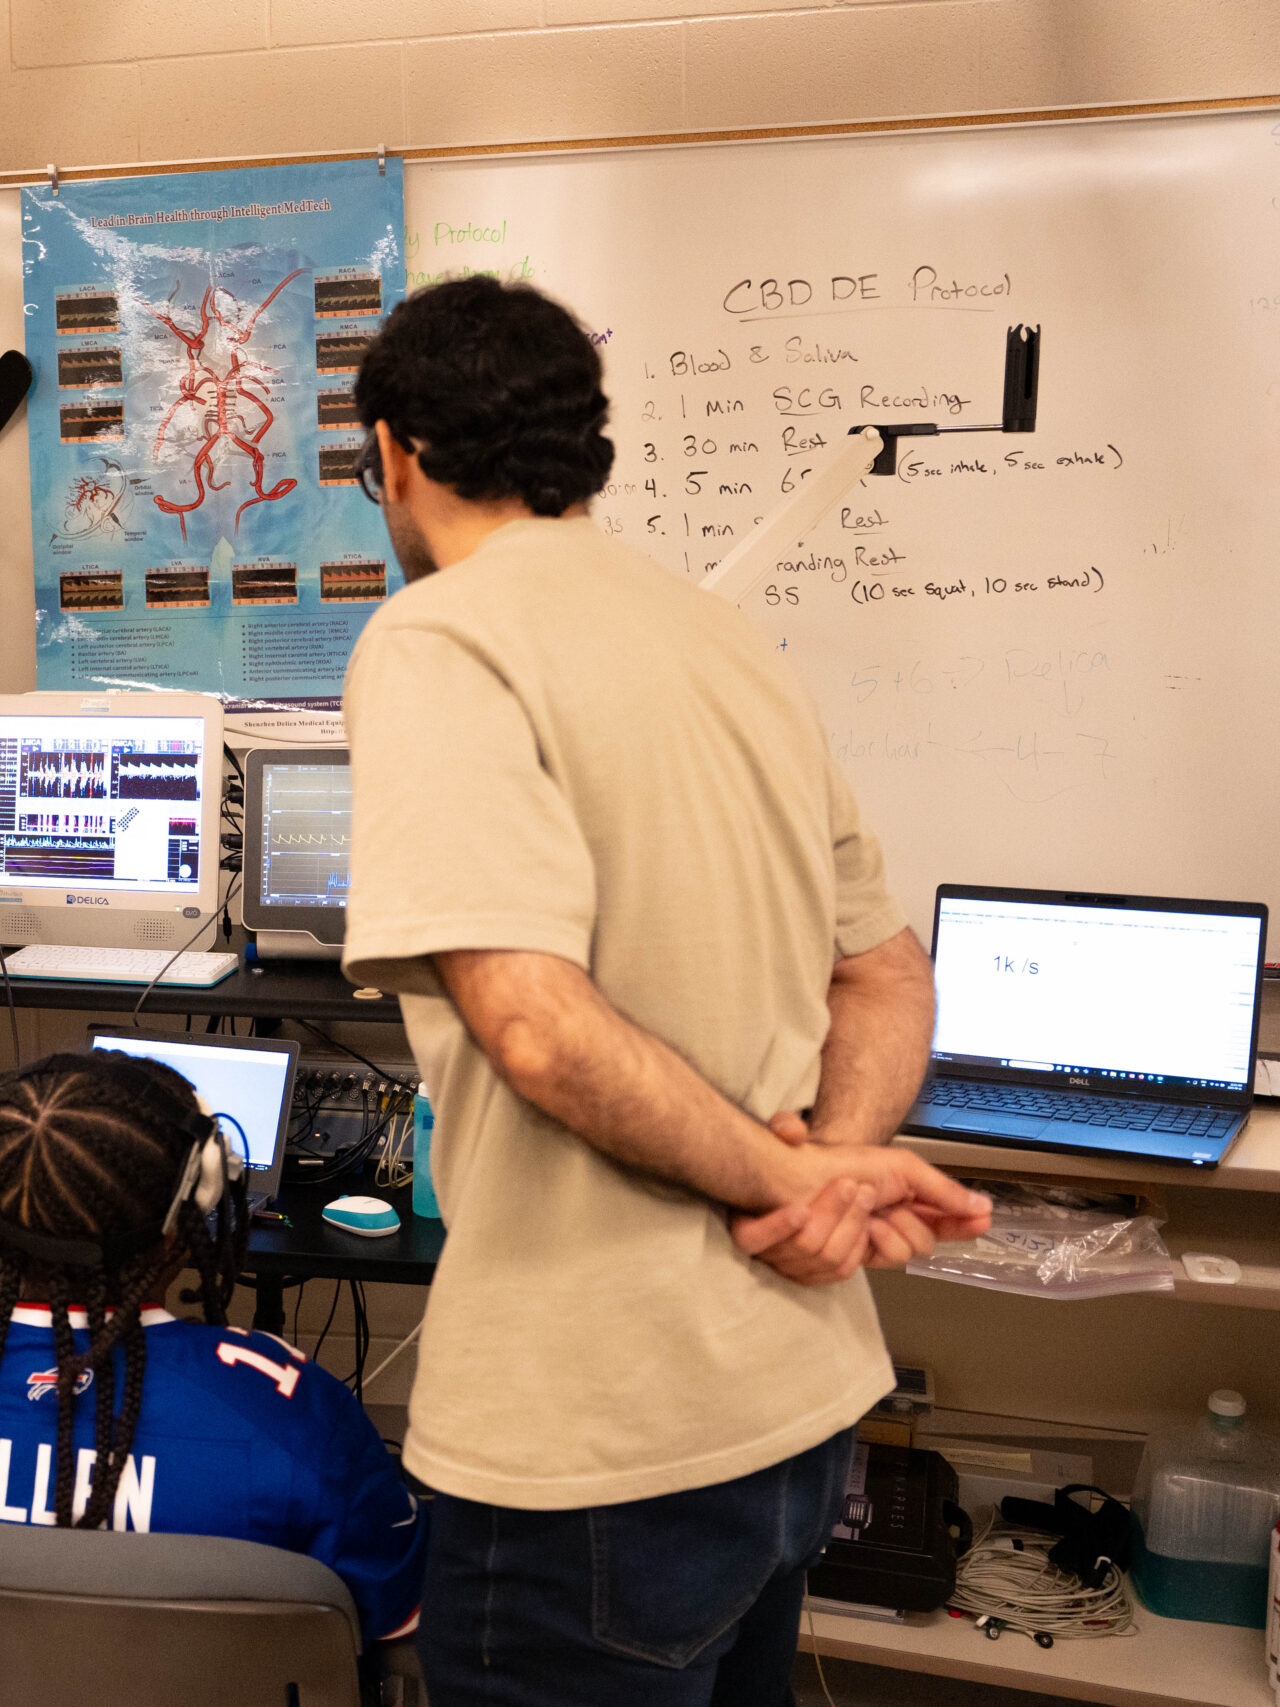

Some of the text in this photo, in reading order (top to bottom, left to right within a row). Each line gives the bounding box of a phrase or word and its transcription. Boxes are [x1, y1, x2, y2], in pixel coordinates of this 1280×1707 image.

[91, 198, 332, 228] Lead in Brain Health through Intelligent MedTech
[434, 220, 507, 246] Protocol
[723, 265, 1011, 313] CBD DE Protocol
[670, 349, 731, 377] Blood
[749, 346, 769, 363] &
[785, 336, 859, 364] Saliva
[641, 385, 971, 421] 2. SCG Recording
[644, 426, 827, 462] 3. 30 min Rest
[898, 450, 924, 483] (5
[924, 467, 942, 476] sec
[1004, 451, 1024, 468] 5
[1024, 461, 1045, 470] sec
[645, 471, 752, 498] 4. 5 min
[647, 515, 666, 536] 5.
[702, 523, 734, 537] min
[841, 507, 888, 529] Rest
[855, 546, 906, 567] Rest
[851, 580, 885, 604] (10
[892, 586, 915, 597] sec
[985, 577, 1006, 594] 10
[1014, 582, 1037, 592] sec
[77, 896, 110, 905] DELICA
[993, 956, 1015, 973] 1k
[1069, 1076, 1090, 1087] DELL
